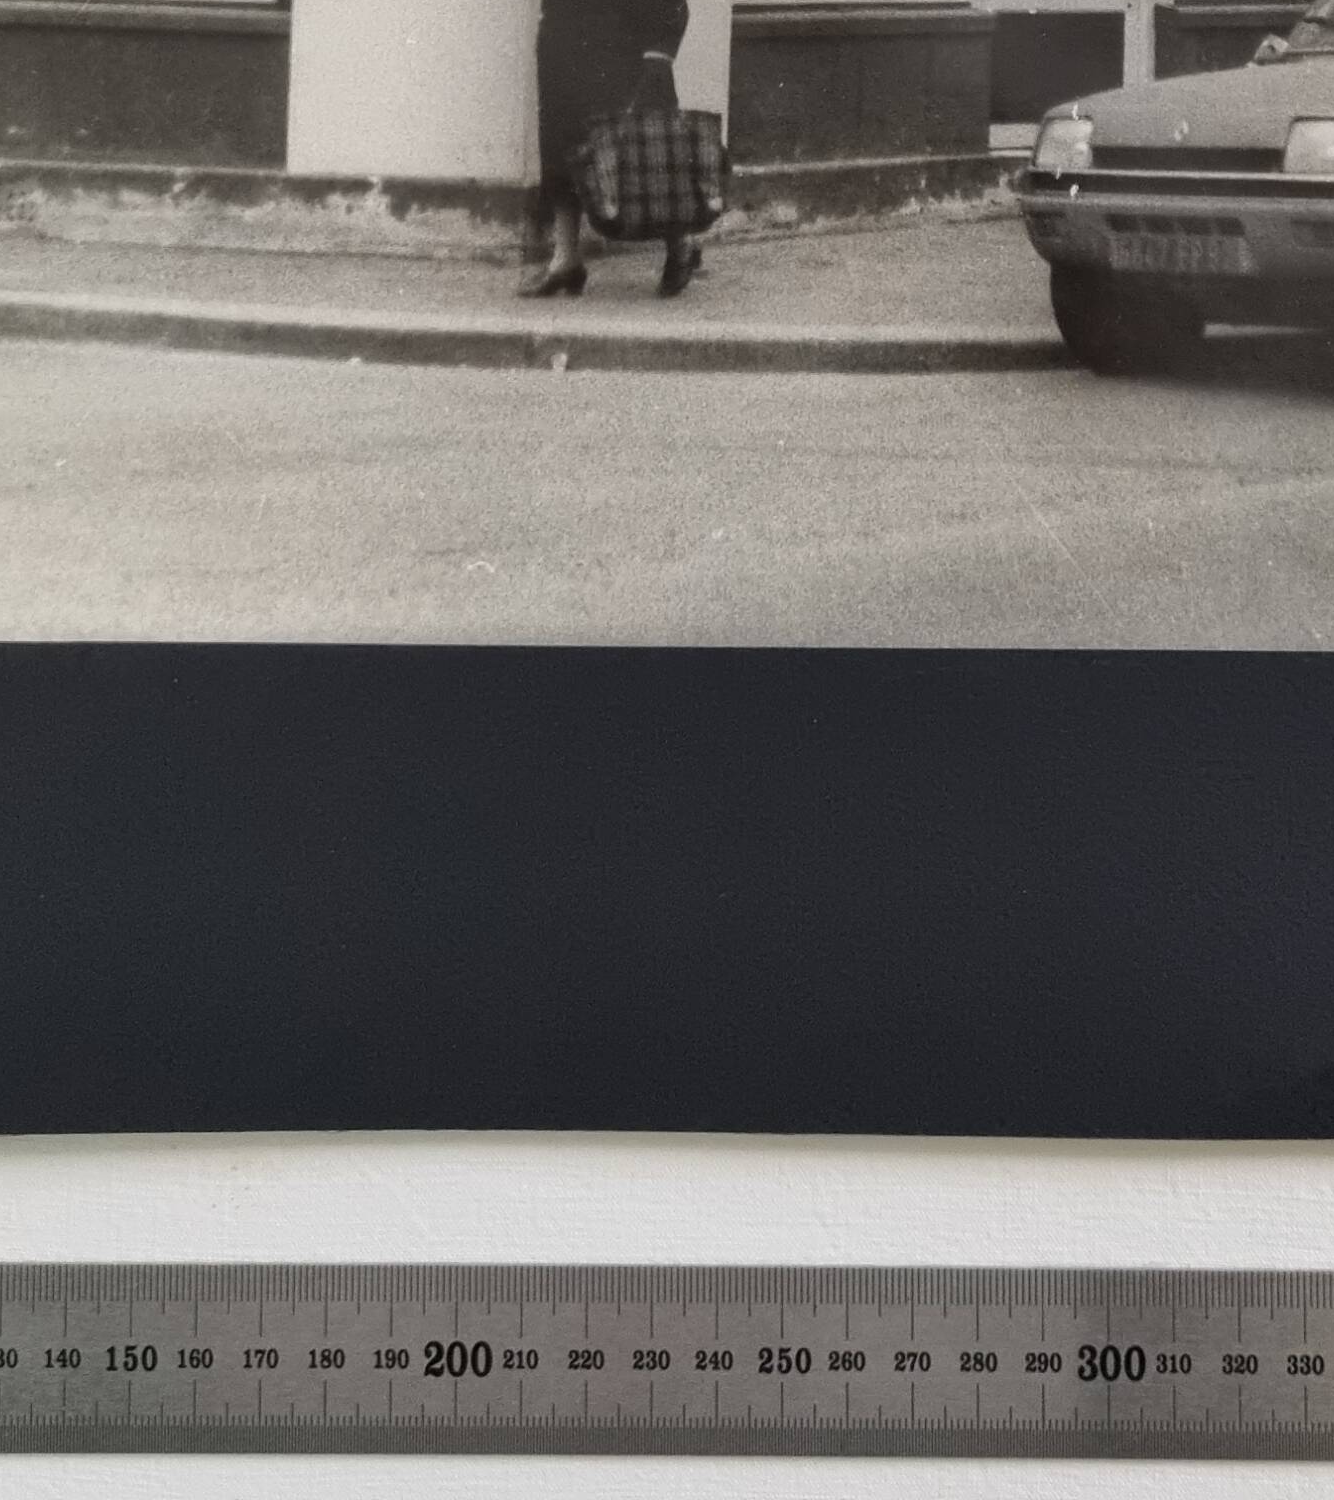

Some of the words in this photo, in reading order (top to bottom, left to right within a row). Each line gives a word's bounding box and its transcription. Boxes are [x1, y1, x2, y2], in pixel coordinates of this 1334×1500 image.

[44, 1348, 82, 1369] 140
[105, 1344, 158, 1372] 150
[177, 1347, 214, 1370] 160
[243, 1348, 280, 1370] 170
[308, 1348, 346, 1370] 180
[373, 1348, 410, 1370] 190
[423, 1340, 493, 1378] 200
[502, 1348, 540, 1370] 210
[567, 1349, 605, 1371] 220
[632, 1349, 671, 1371] 230
[694, 1349, 734, 1371] 240
[757, 1346, 812, 1375] 250
[828, 1350, 866, 1372] 260
[894, 1350, 932, 1373] 270
[959, 1351, 999, 1373] 280
[1024, 1352, 1063, 1374] 290
[1077, 1344, 1147, 1382] 300
[1155, 1353, 1192, 1375] 310
[1221, 1353, 1259, 1375] 320
[1286, 1354, 1325, 1376] 330
